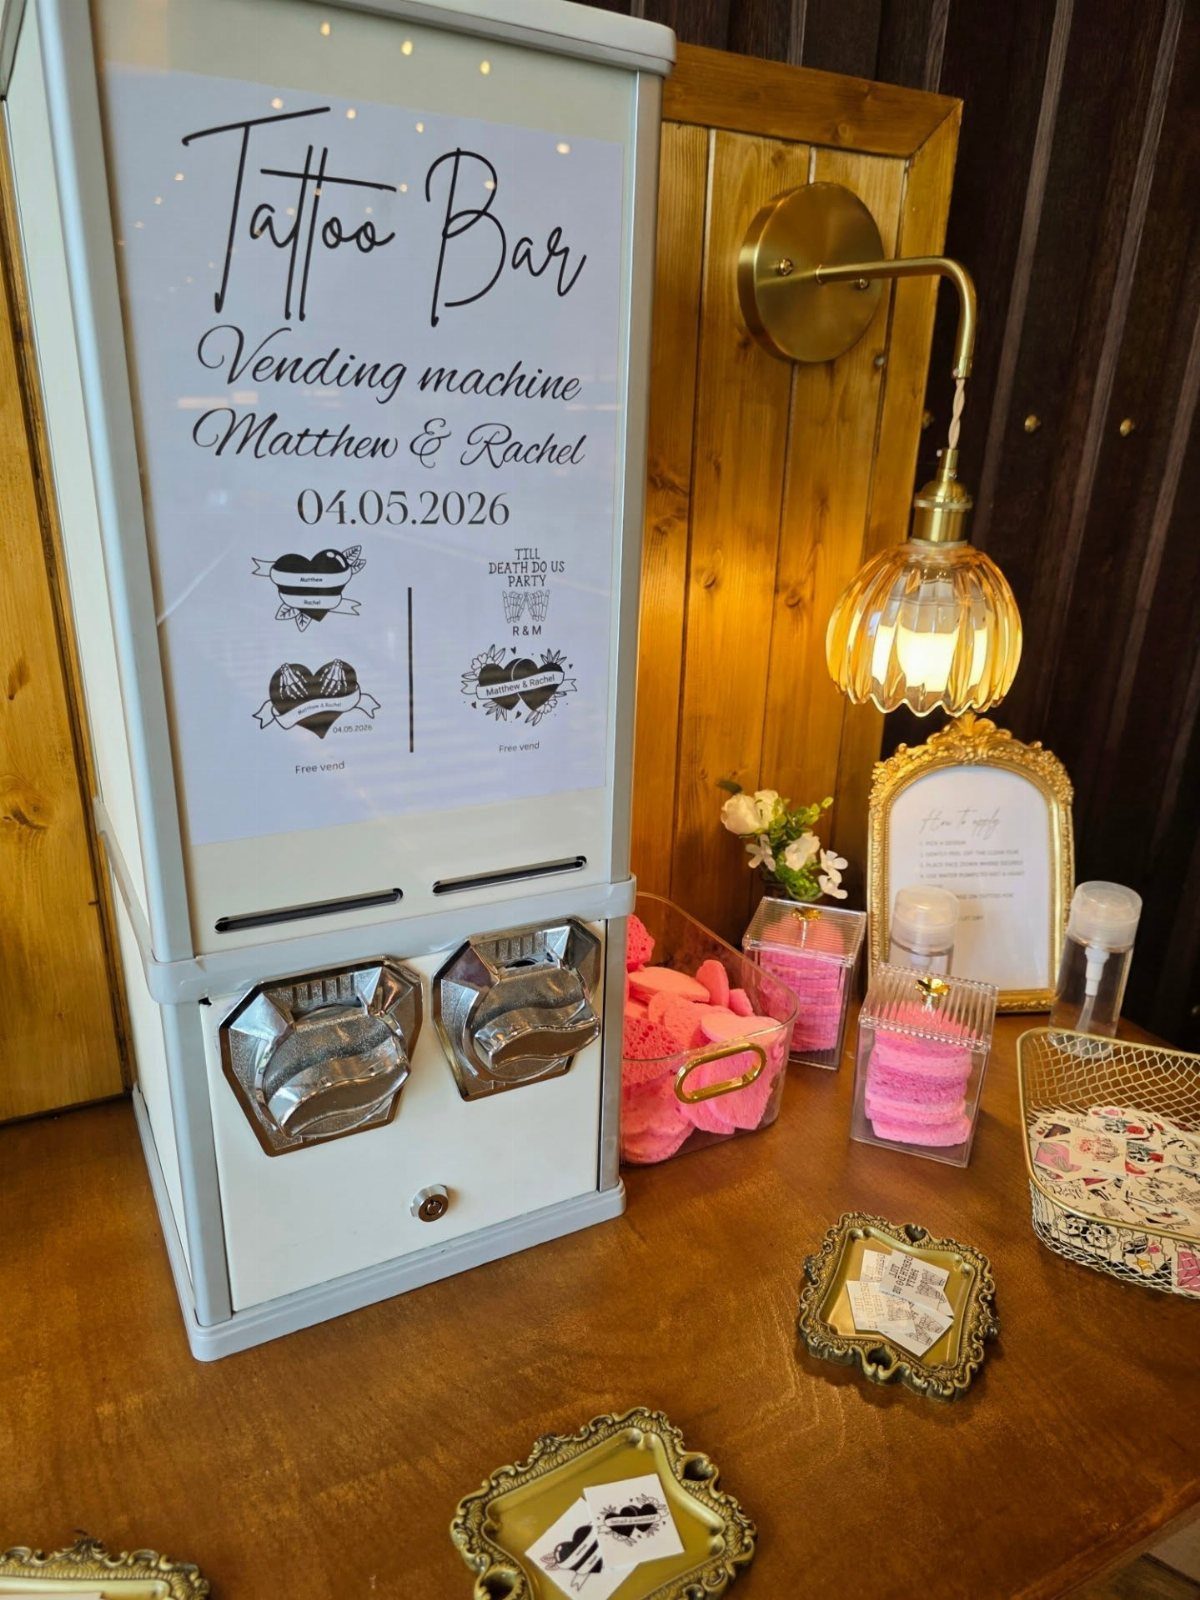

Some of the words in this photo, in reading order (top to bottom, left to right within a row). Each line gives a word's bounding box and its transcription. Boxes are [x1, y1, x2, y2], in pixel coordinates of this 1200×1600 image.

[181, 106, 397, 321] Tattoo
[426, 148, 587, 327] Bar
[197, 325, 407, 404] Vending
[418, 361, 582, 401] machine
[192, 407, 398, 459] Matthew
[409, 417, 452, 468] &
[460, 423, 587, 468] Rachel
[297, 488, 510, 526] 04.05.2026
[514, 548, 541, 561] TILL
[488, 560, 528, 574] DEATH
[531, 560, 548, 573] DO
[551, 560, 565, 573] US
[508, 574, 548, 587] PARTY
[512, 625, 520, 636] R
[522, 625, 530, 636] &
[531, 625, 542, 636] M
[485, 682, 521, 697] Matthew
[522, 680, 528, 689] &
[529, 674, 556, 687] Rachel
[498, 744, 518, 753] Free
[519, 741, 541, 751] vend
[295, 763, 318, 775] Free
[319, 761, 345, 772] vend
